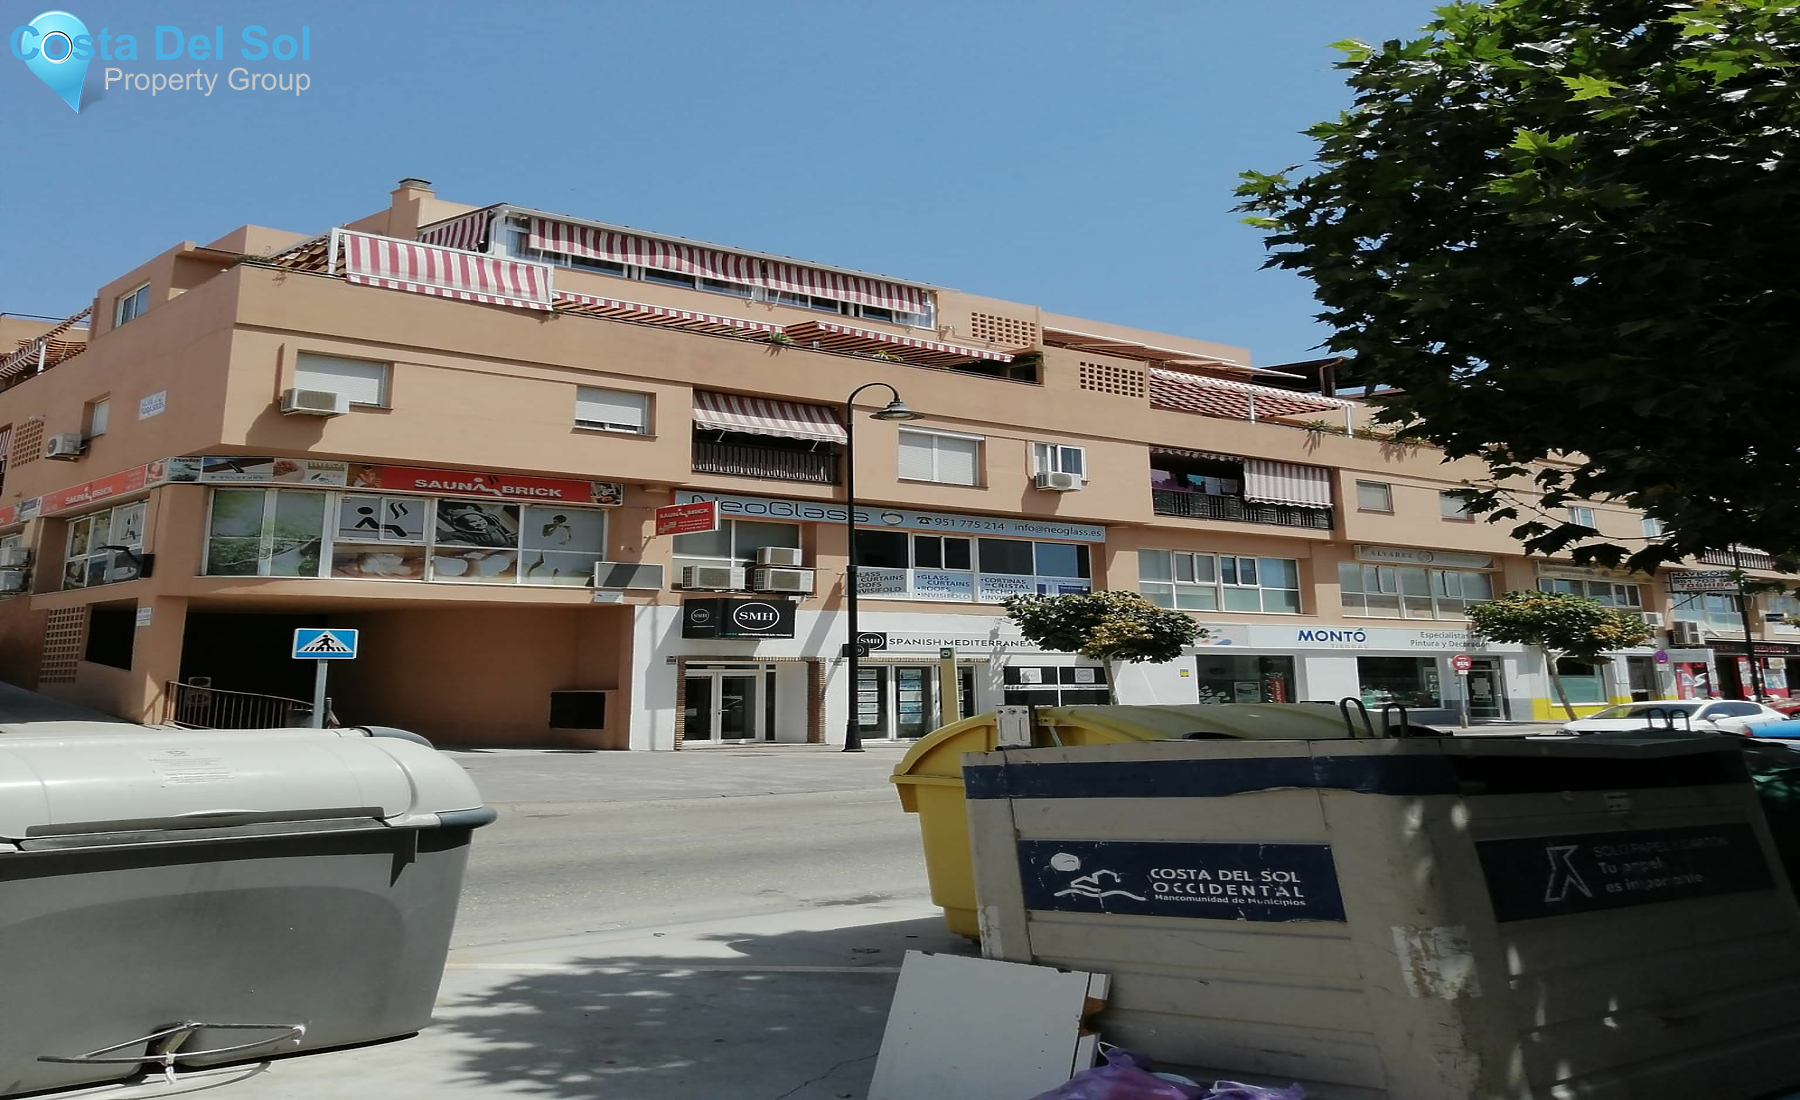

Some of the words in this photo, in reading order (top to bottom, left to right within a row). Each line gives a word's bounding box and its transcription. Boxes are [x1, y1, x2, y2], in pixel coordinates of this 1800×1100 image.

[414, 478, 487, 491] SAUNA
[502, 485, 562, 498] BRICK
[934, 517, 956, 527] 951
[960, 519, 981, 529] 775
[984, 521, 1005, 531] 214
[1014, 524, 1102, 538] info@neoglass.es
[1369, 550, 1413, 559] ALVAREZ
[861, 574, 904, 582] CURTAINS
[927, 580, 970, 588] CURTAINS
[991, 582, 1031, 590] CRISTAL
[738, 611, 774, 621] SMH
[1298, 628, 1367, 643] MONTÓ
[1420, 631, 1471, 641] Especialistas
[889, 638, 941, 646] SPANISH
[1410, 640, 1441, 648] Pintura
[1441, 641, 1446, 649] y
[1448, 640, 1490, 649] Decoración
[1598, 861, 1618, 874] Tu
[1150, 868, 1212, 881] COSTA
[1218, 870, 1254, 882] DEL
[1260, 870, 1301, 883] SOL
[1153, 882, 1304, 898] OCCIDENTAL
[1606, 881, 1623, 894] es
[1155, 894, 1229, 904] Mancomunidad
[1249, 897, 1307, 907] Municipios
